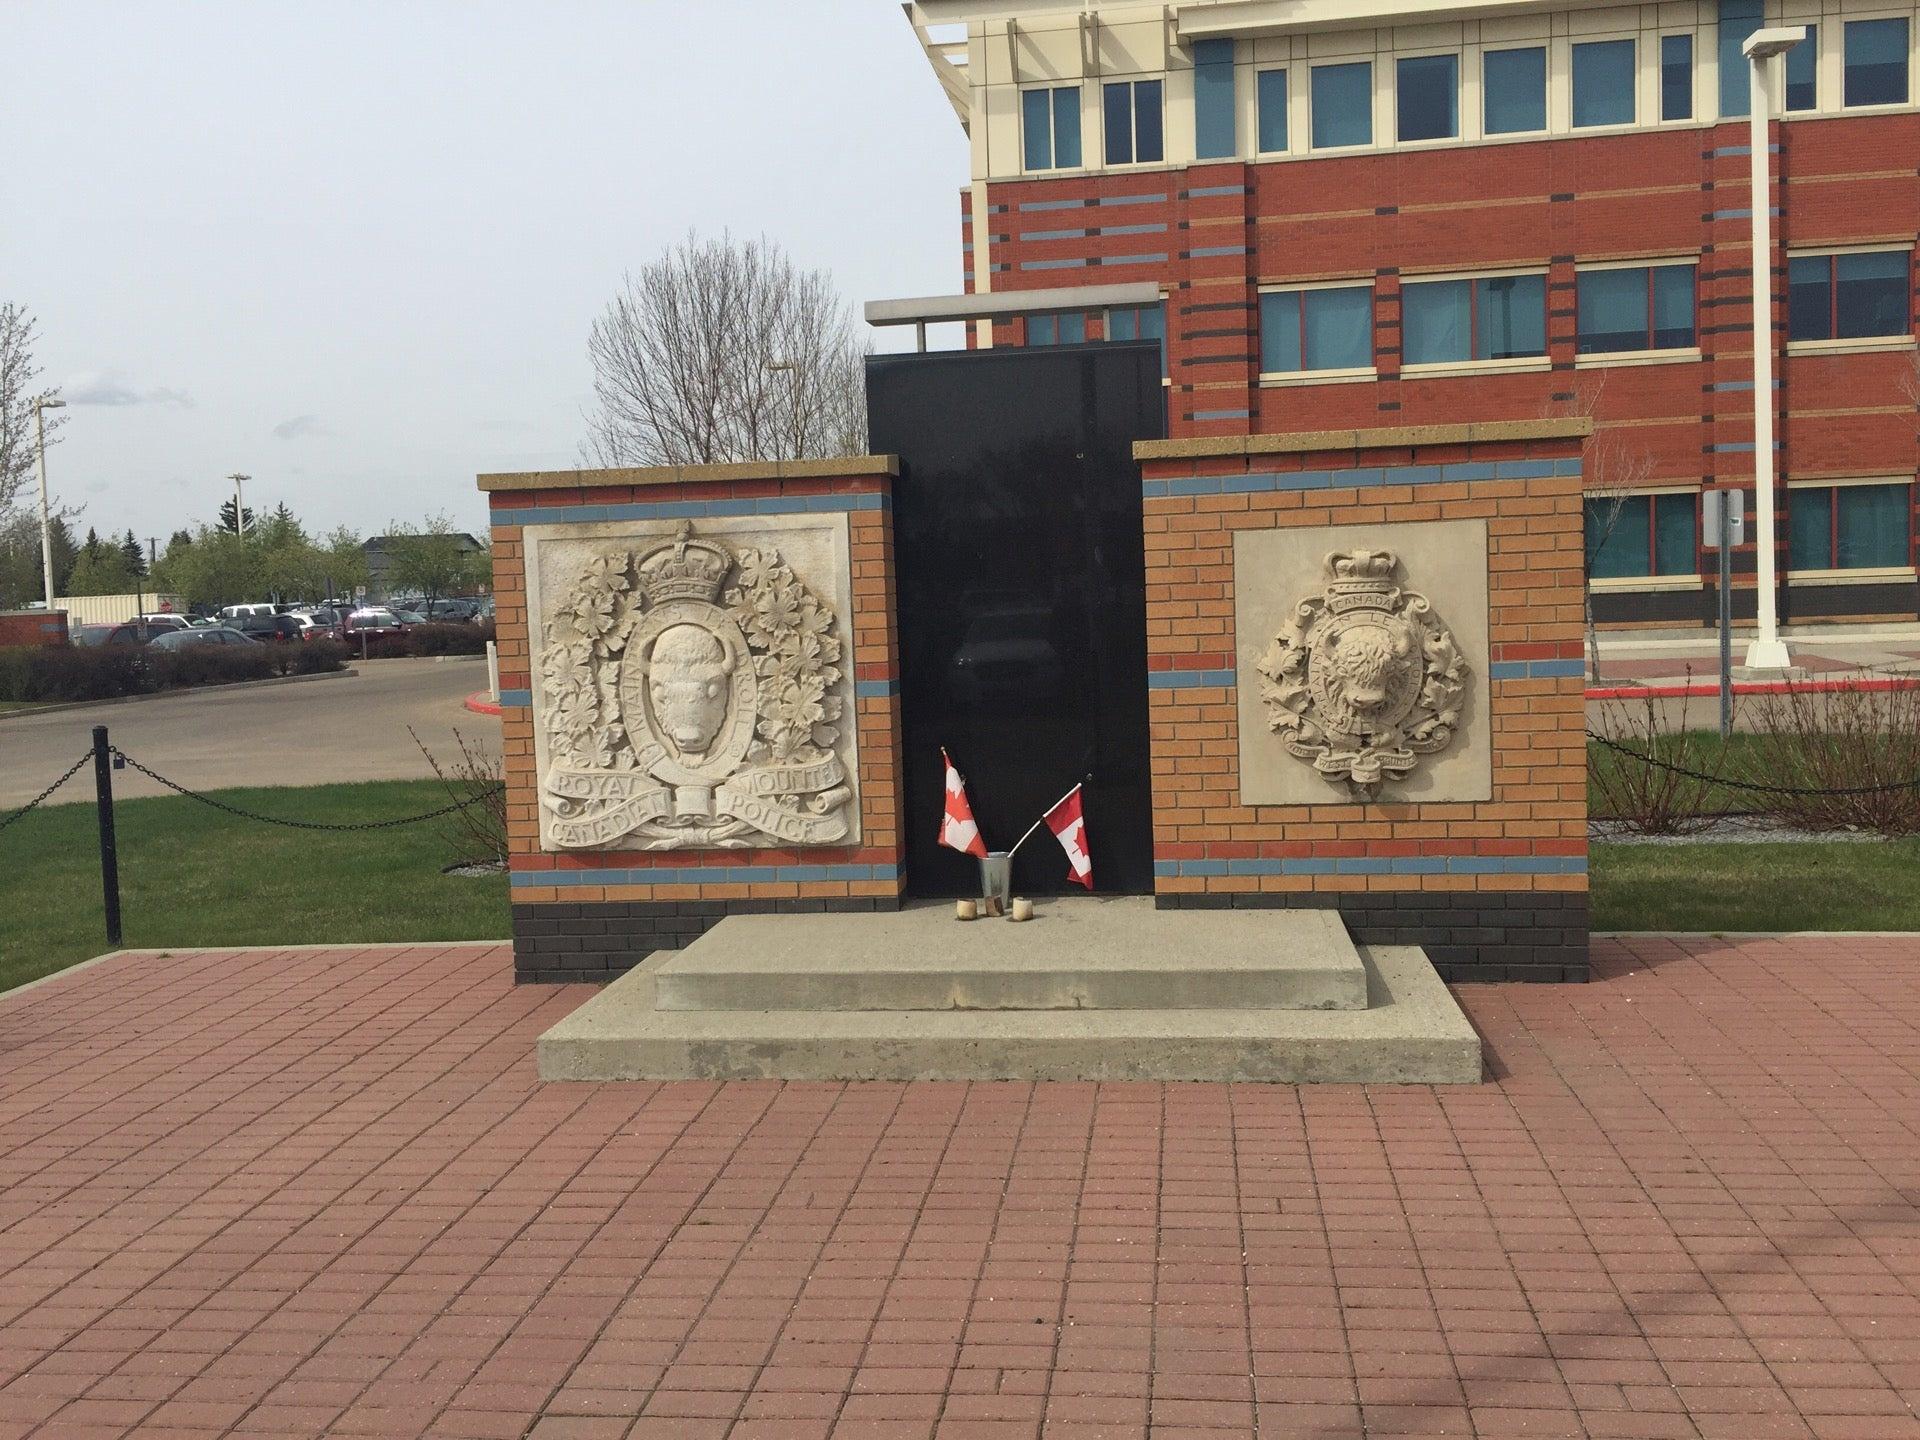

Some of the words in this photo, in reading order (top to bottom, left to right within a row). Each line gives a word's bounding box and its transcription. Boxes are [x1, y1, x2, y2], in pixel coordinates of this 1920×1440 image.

[1336, 595, 1392, 610] CANADA
[1371, 612, 1393, 626] LE
[558, 774, 640, 797] ROYAL
[740, 762, 843, 794] MOUNTED
[552, 790, 664, 843] CANADIAN
[731, 794, 818, 839] POLICE
